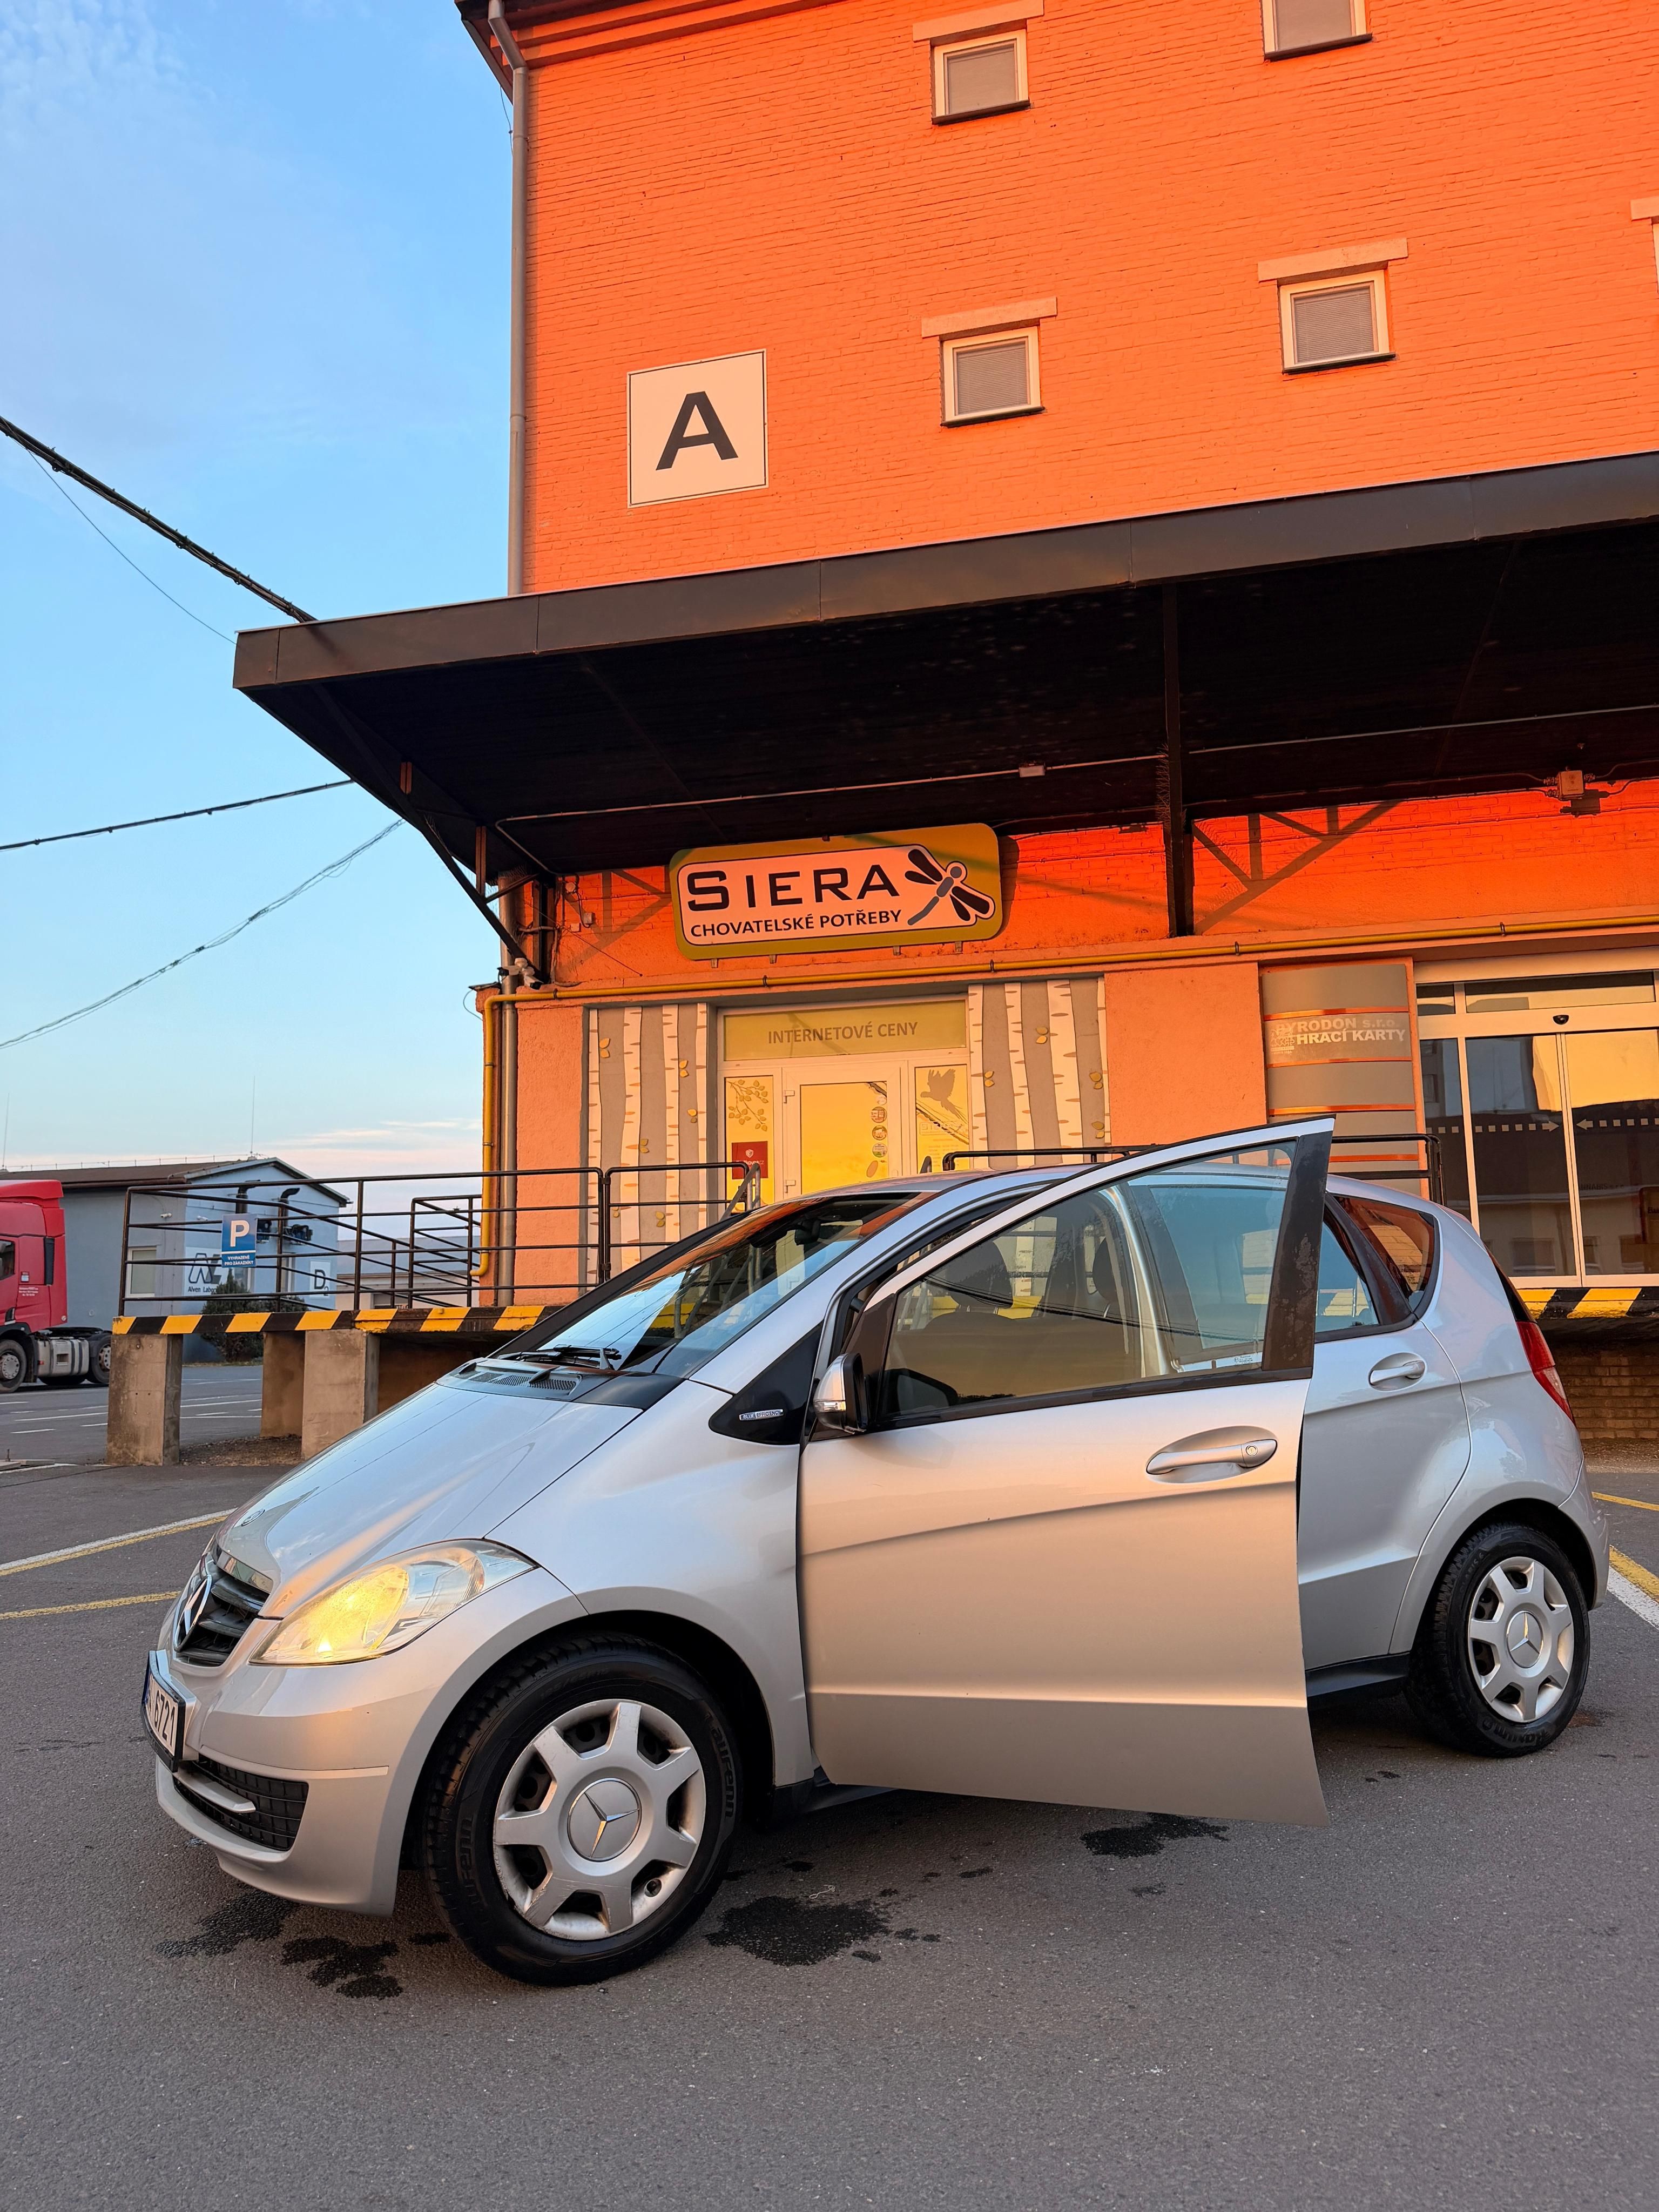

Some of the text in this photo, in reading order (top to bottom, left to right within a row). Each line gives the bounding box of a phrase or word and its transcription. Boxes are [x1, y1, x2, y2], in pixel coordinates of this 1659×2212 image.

[656, 391, 738, 470] A
[687, 865, 900, 911] SIERA
[691, 909, 902, 936] CHOVATELSKÉ POTŘEBY
[768, 1021, 918, 1044] INTERNETOVÉ CENY
[1297, 1028, 1406, 1045] HRACÍ KARTY
[230, 1220, 249, 1247] P
[154, 1690, 176, 1747] 6721
